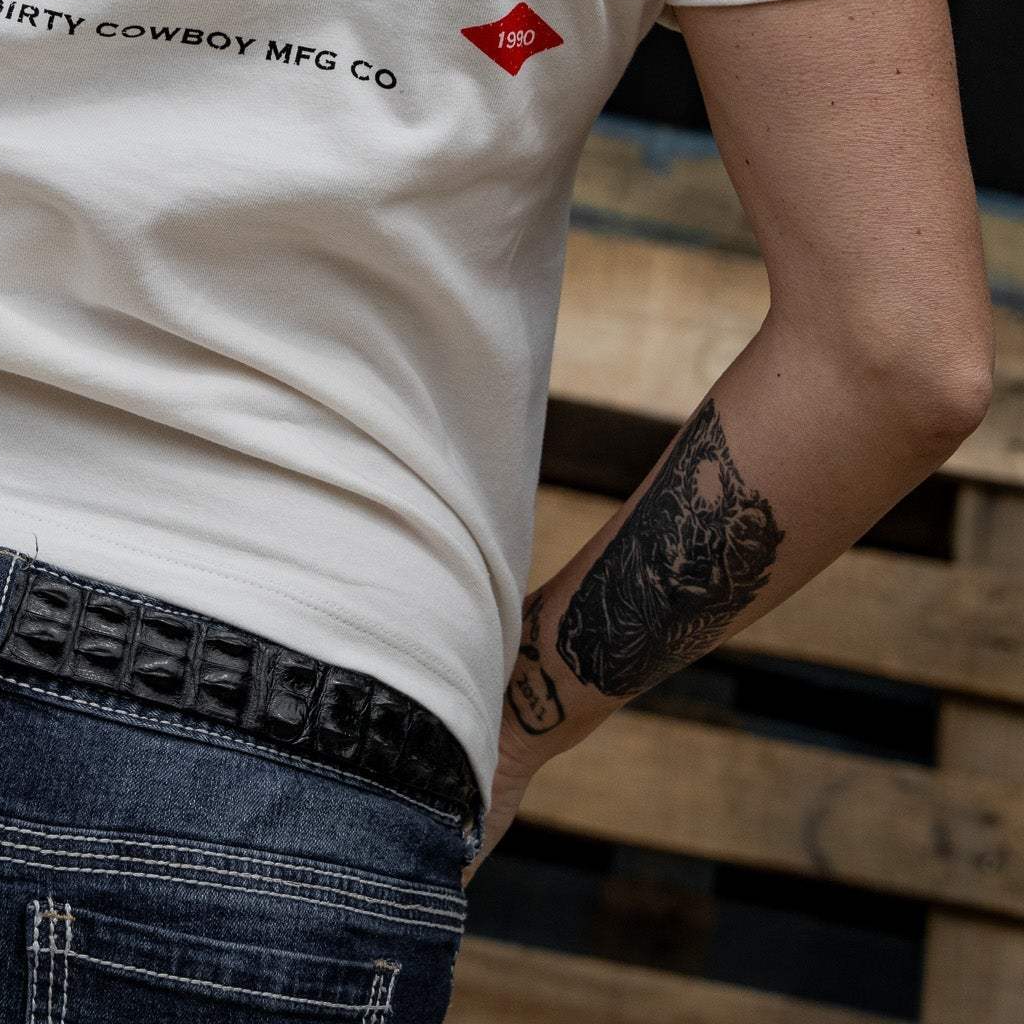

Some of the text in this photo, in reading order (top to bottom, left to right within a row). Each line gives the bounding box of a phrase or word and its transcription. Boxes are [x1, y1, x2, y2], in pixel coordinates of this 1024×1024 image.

[95, 21, 257, 56] COWBOY
[265, 40, 338, 72] MFG
[350, 59, 398, 90] CO
[497, 29, 536, 49] 1990
